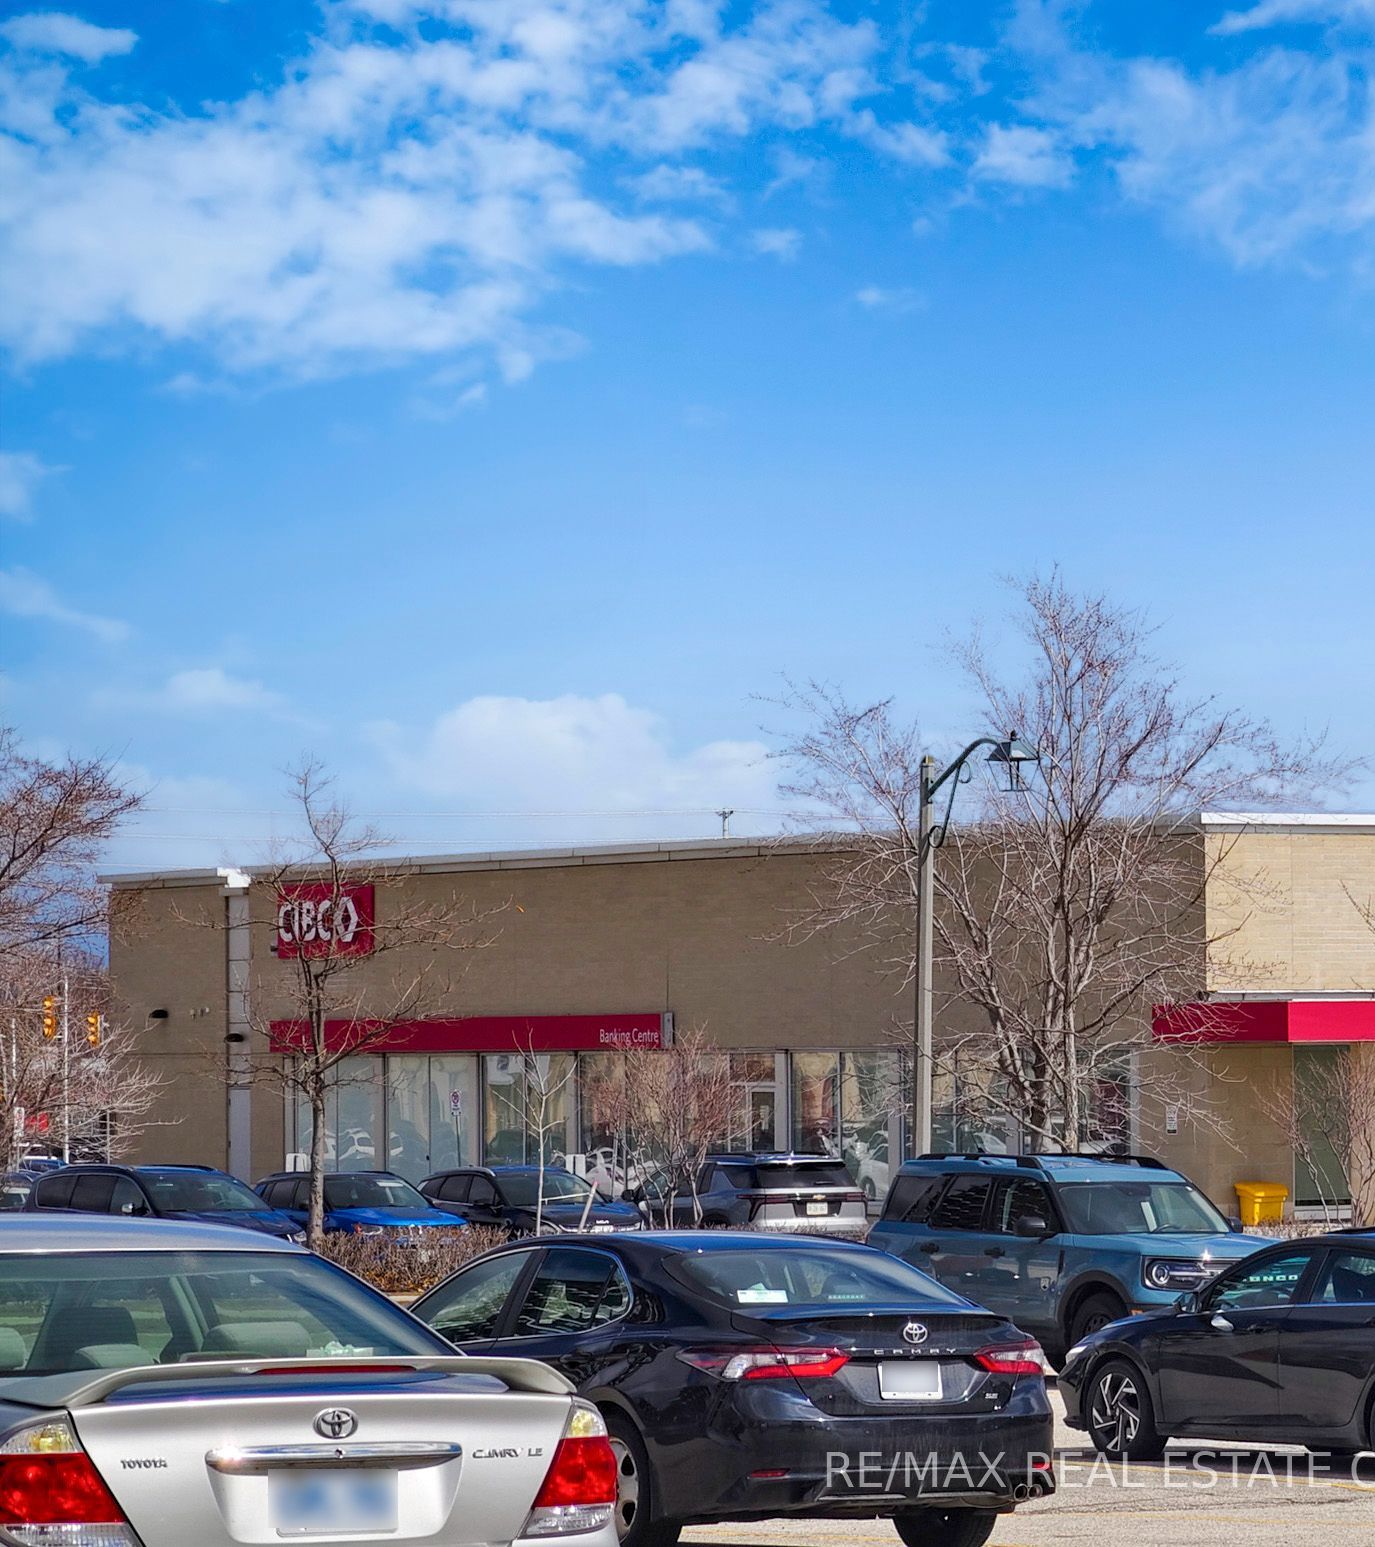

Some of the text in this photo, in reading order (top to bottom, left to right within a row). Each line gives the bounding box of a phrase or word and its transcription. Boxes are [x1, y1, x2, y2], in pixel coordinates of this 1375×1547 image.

[278, 898, 334, 942] CIBC
[599, 1028, 659, 1046] Banking Centre
[1242, 1274, 1299, 1282] ONCO
[527, 1447, 543, 1457] LE
[120, 1458, 168, 1469] TOYOTA
